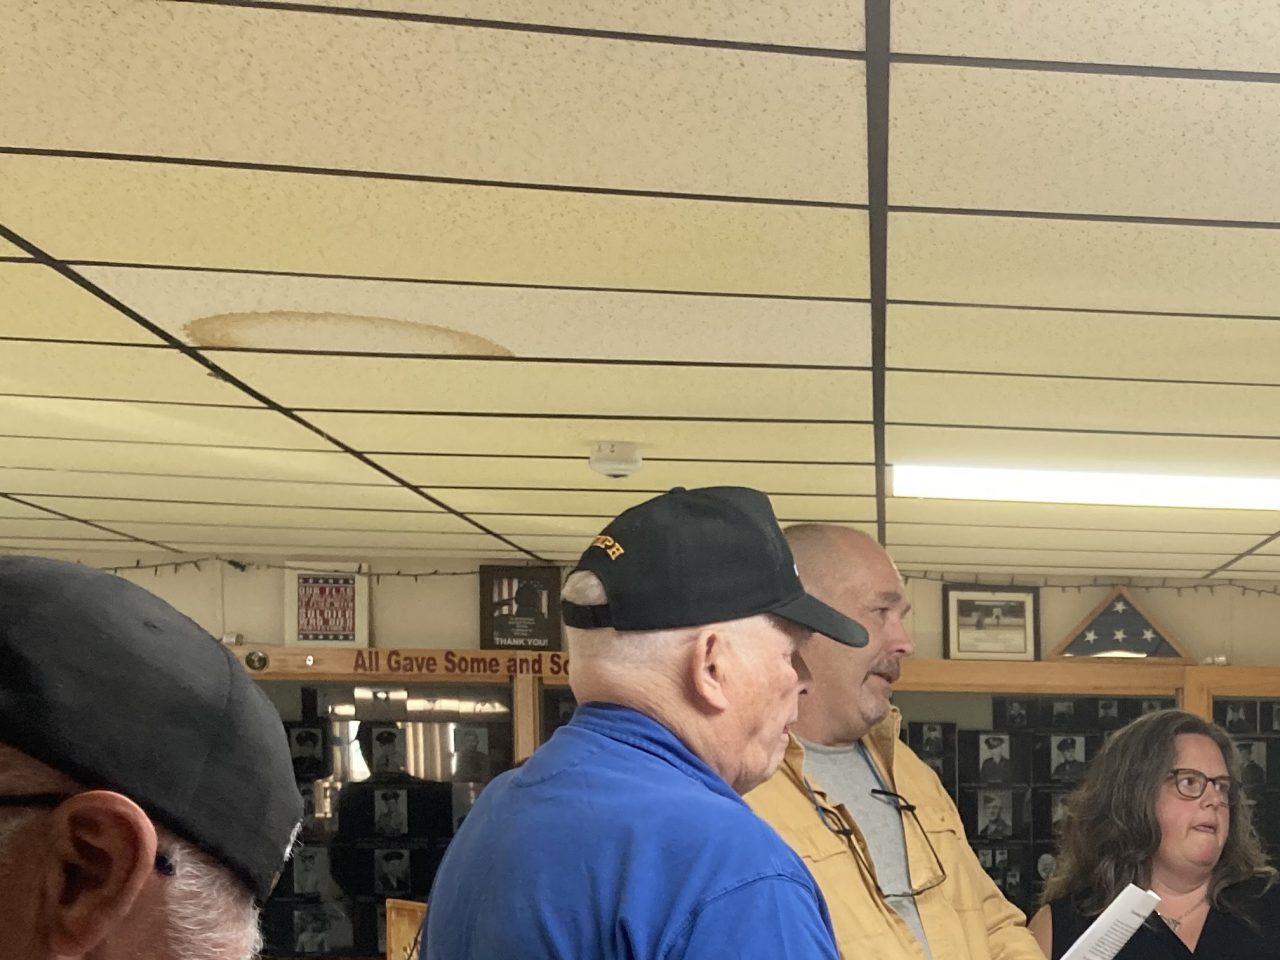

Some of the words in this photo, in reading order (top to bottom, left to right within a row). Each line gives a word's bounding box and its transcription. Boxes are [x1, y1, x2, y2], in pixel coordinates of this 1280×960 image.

[494, 637, 525, 646] THANK
[527, 638, 549, 647] YOU!
[353, 650, 380, 673] All
[387, 650, 438, 674] Gave
[444, 651, 500, 674] Some
[506, 653, 543, 675] and
